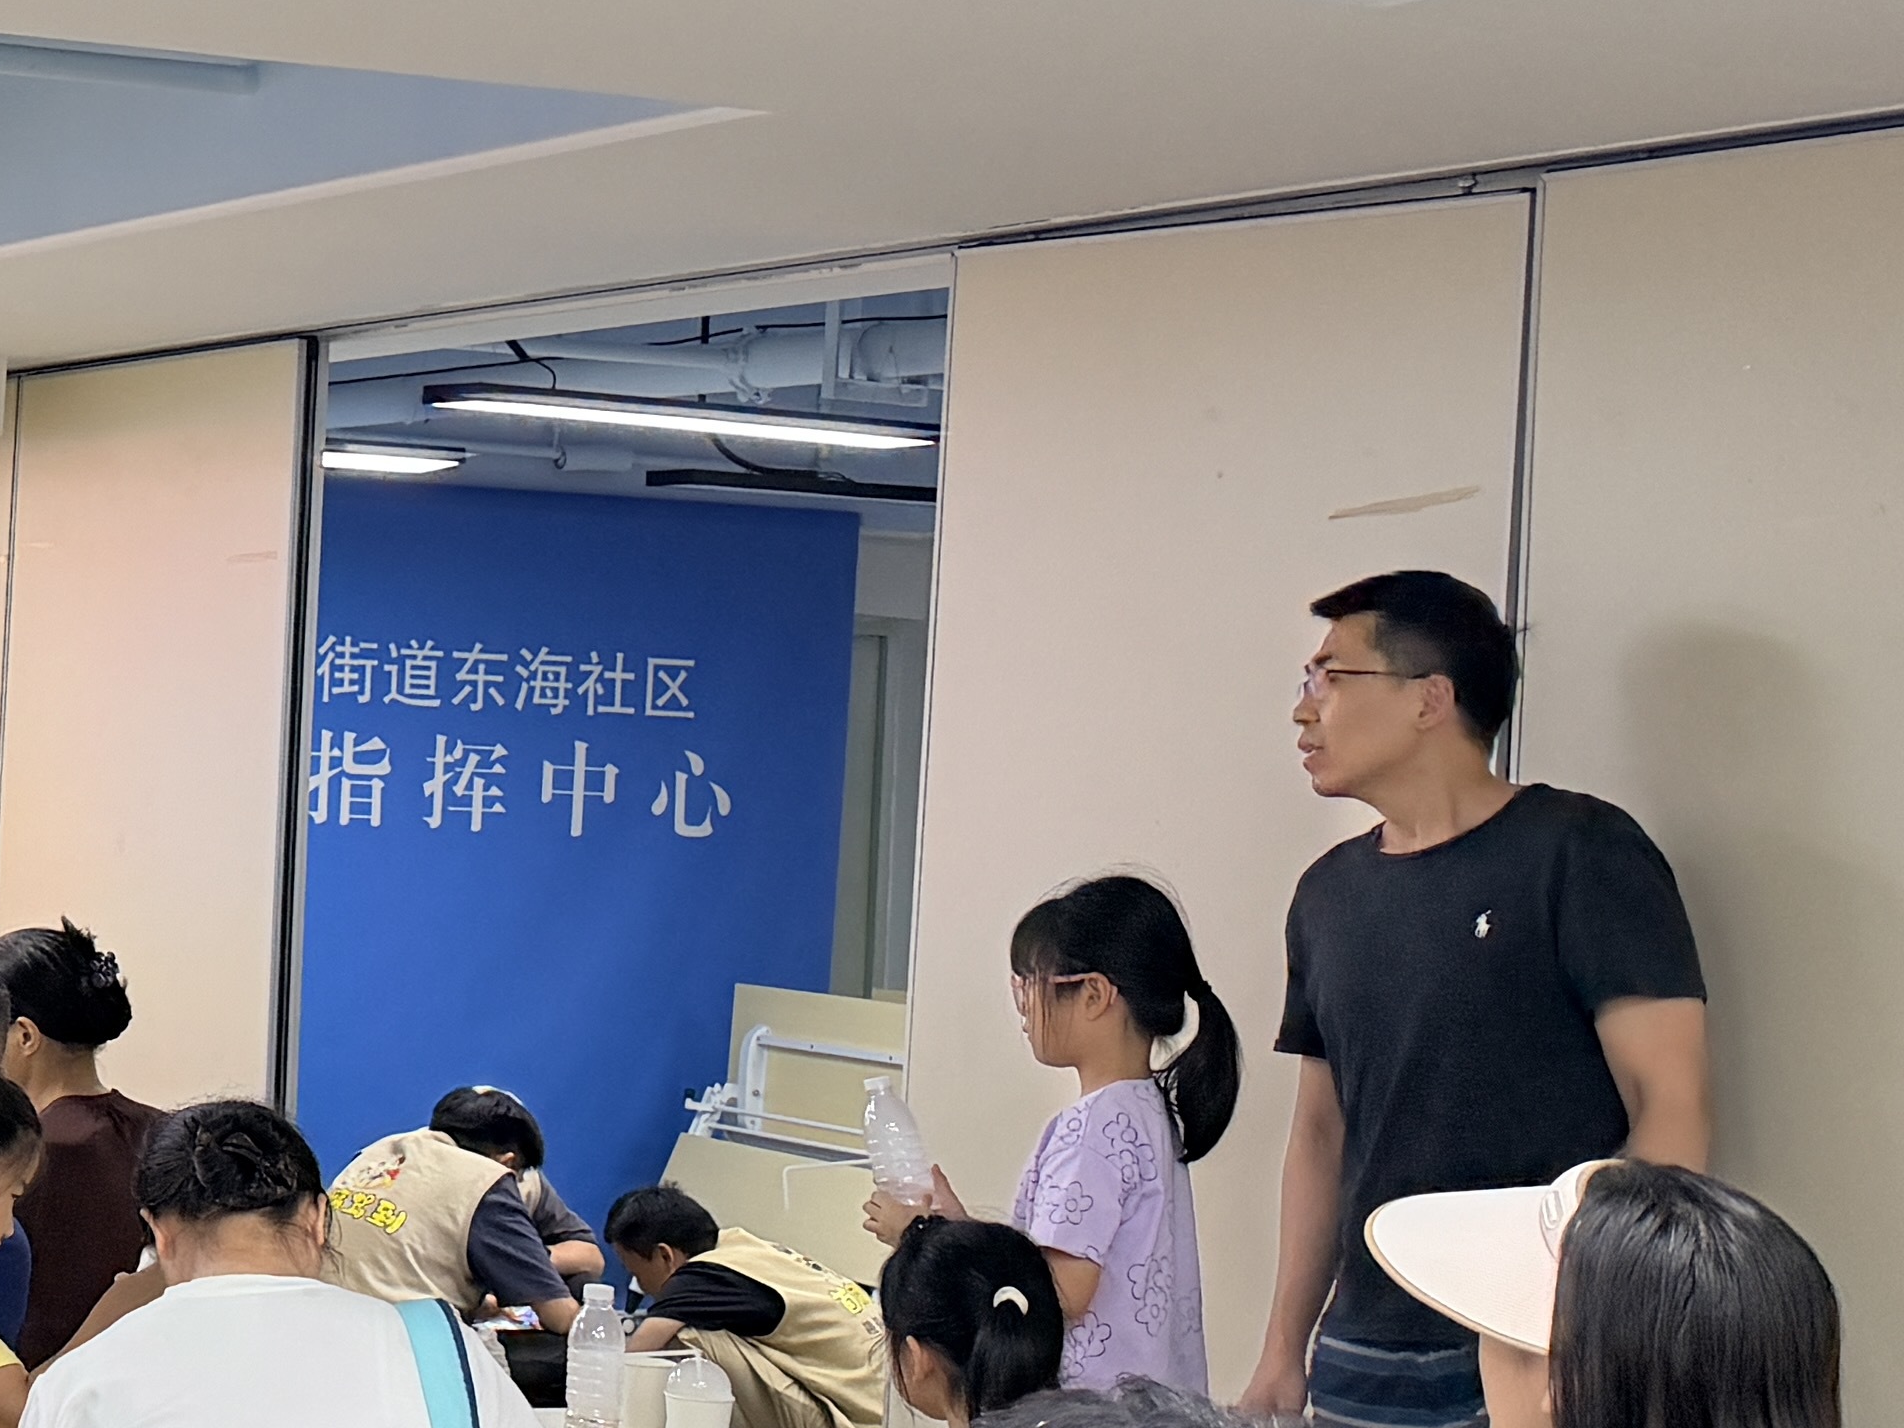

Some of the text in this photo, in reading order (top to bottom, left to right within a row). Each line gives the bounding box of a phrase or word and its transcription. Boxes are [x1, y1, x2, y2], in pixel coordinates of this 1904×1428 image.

[316, 634, 696, 719] 街道东海社区
[308, 728, 733, 839] 指挥中心
